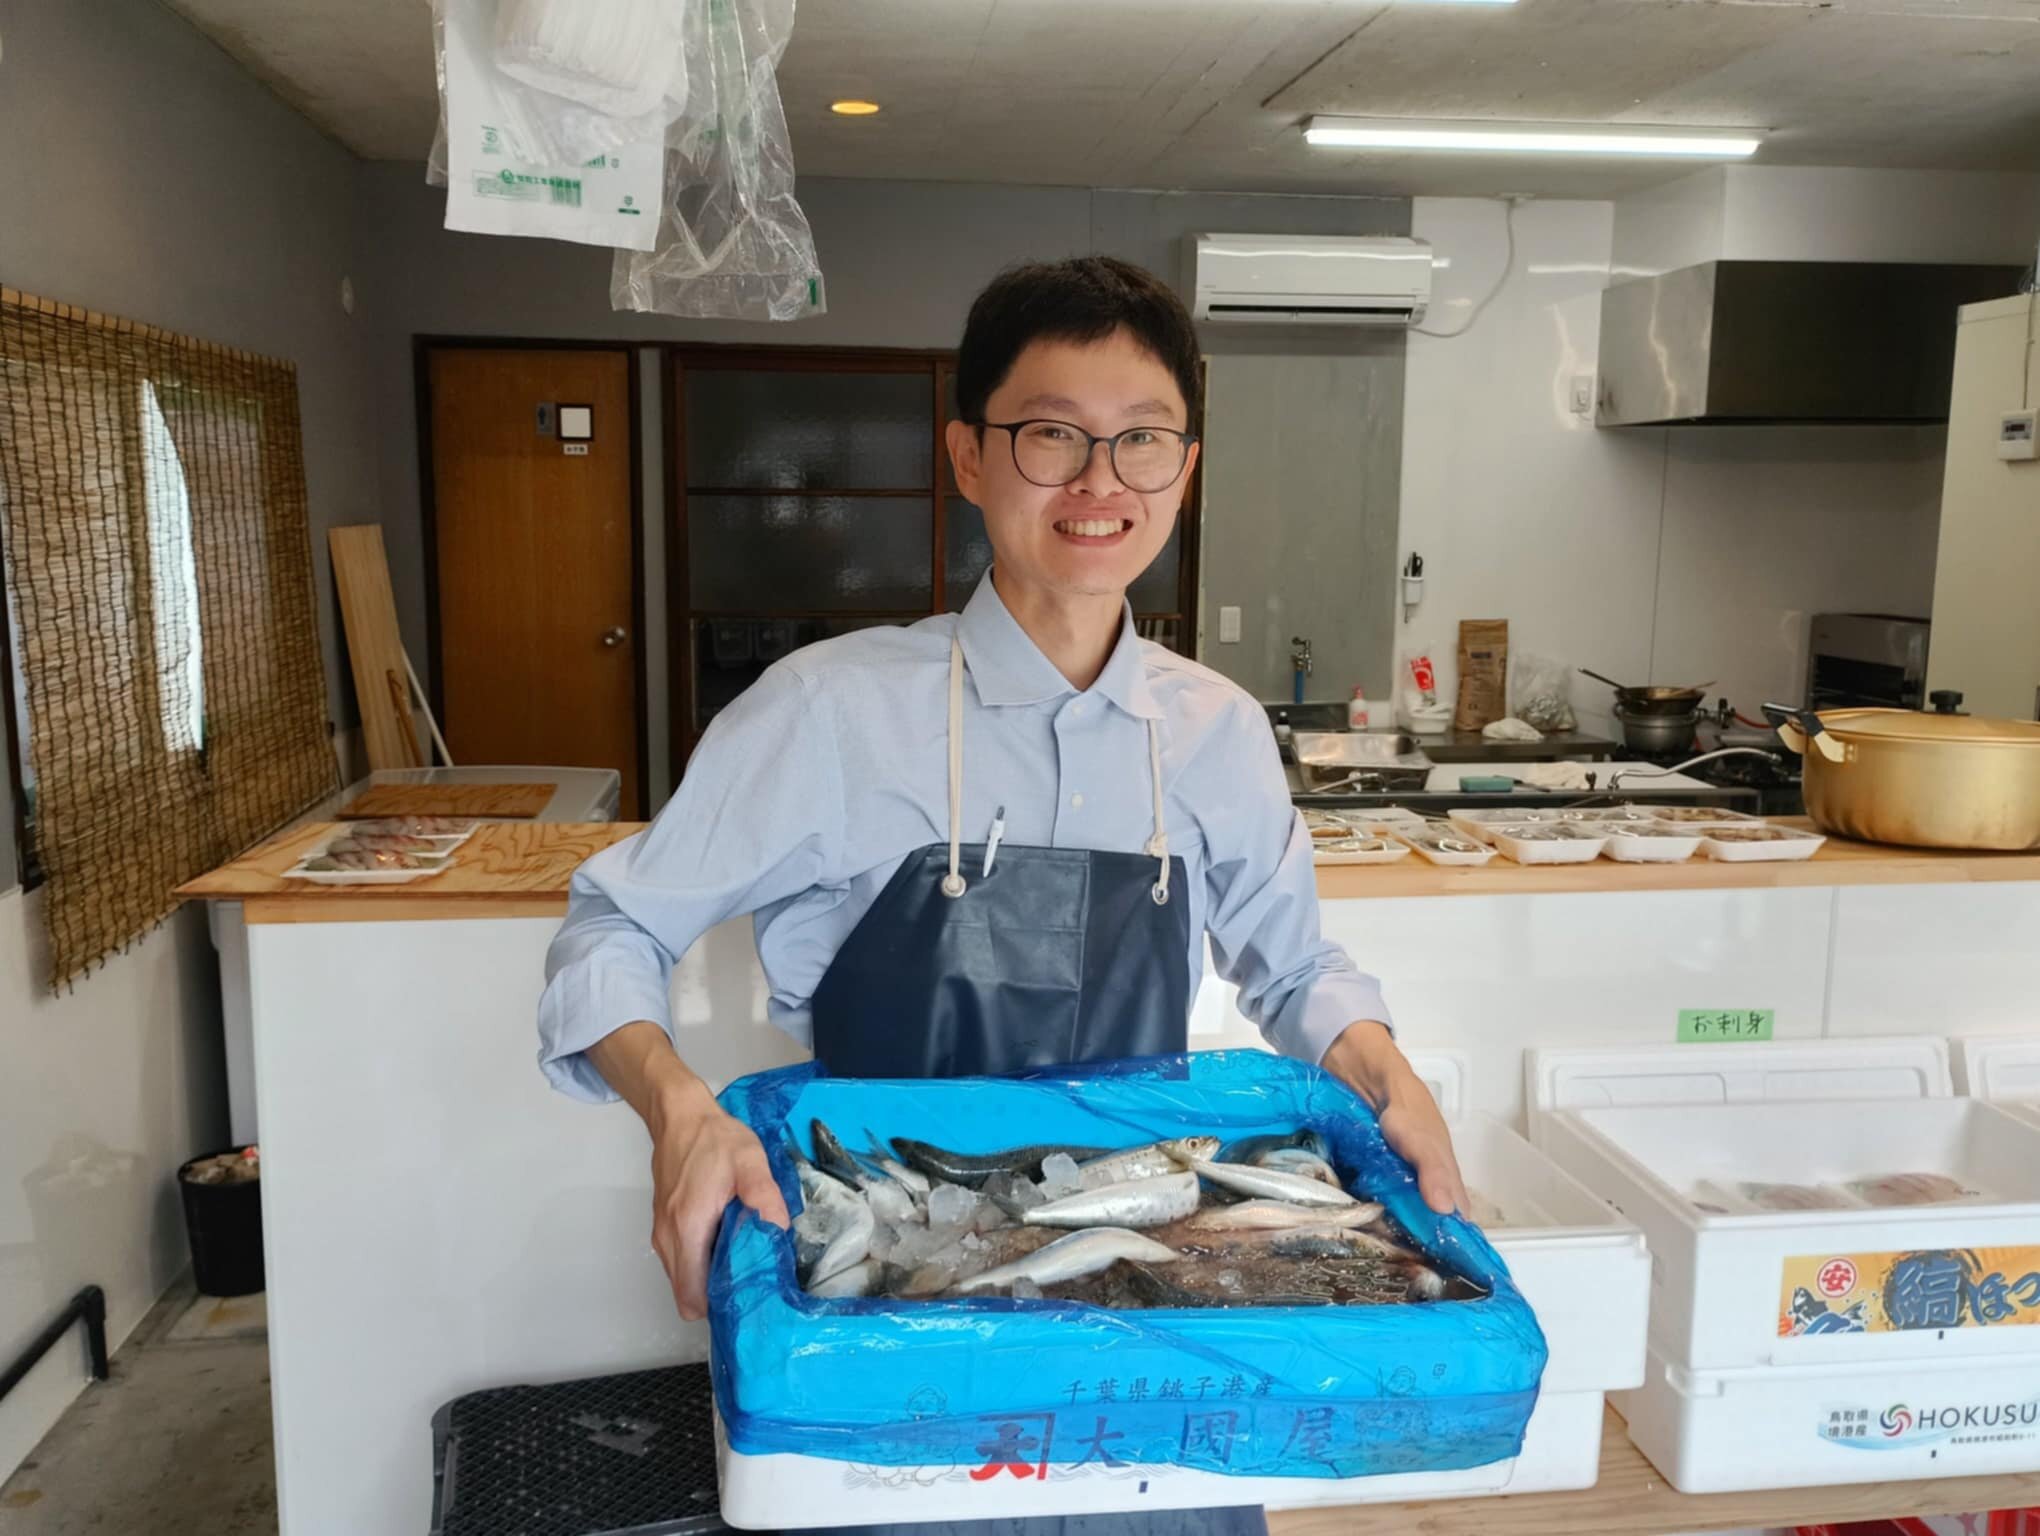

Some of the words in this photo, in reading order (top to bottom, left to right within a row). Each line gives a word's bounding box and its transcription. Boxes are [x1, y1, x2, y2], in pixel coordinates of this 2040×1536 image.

[1692, 1011, 1766, 1035] お刺身
[1820, 1262, 1853, 1294] 安
[1063, 1374, 1274, 1406] 千葉県銚子港産
[1917, 1402, 2038, 1430] HOKUSU
